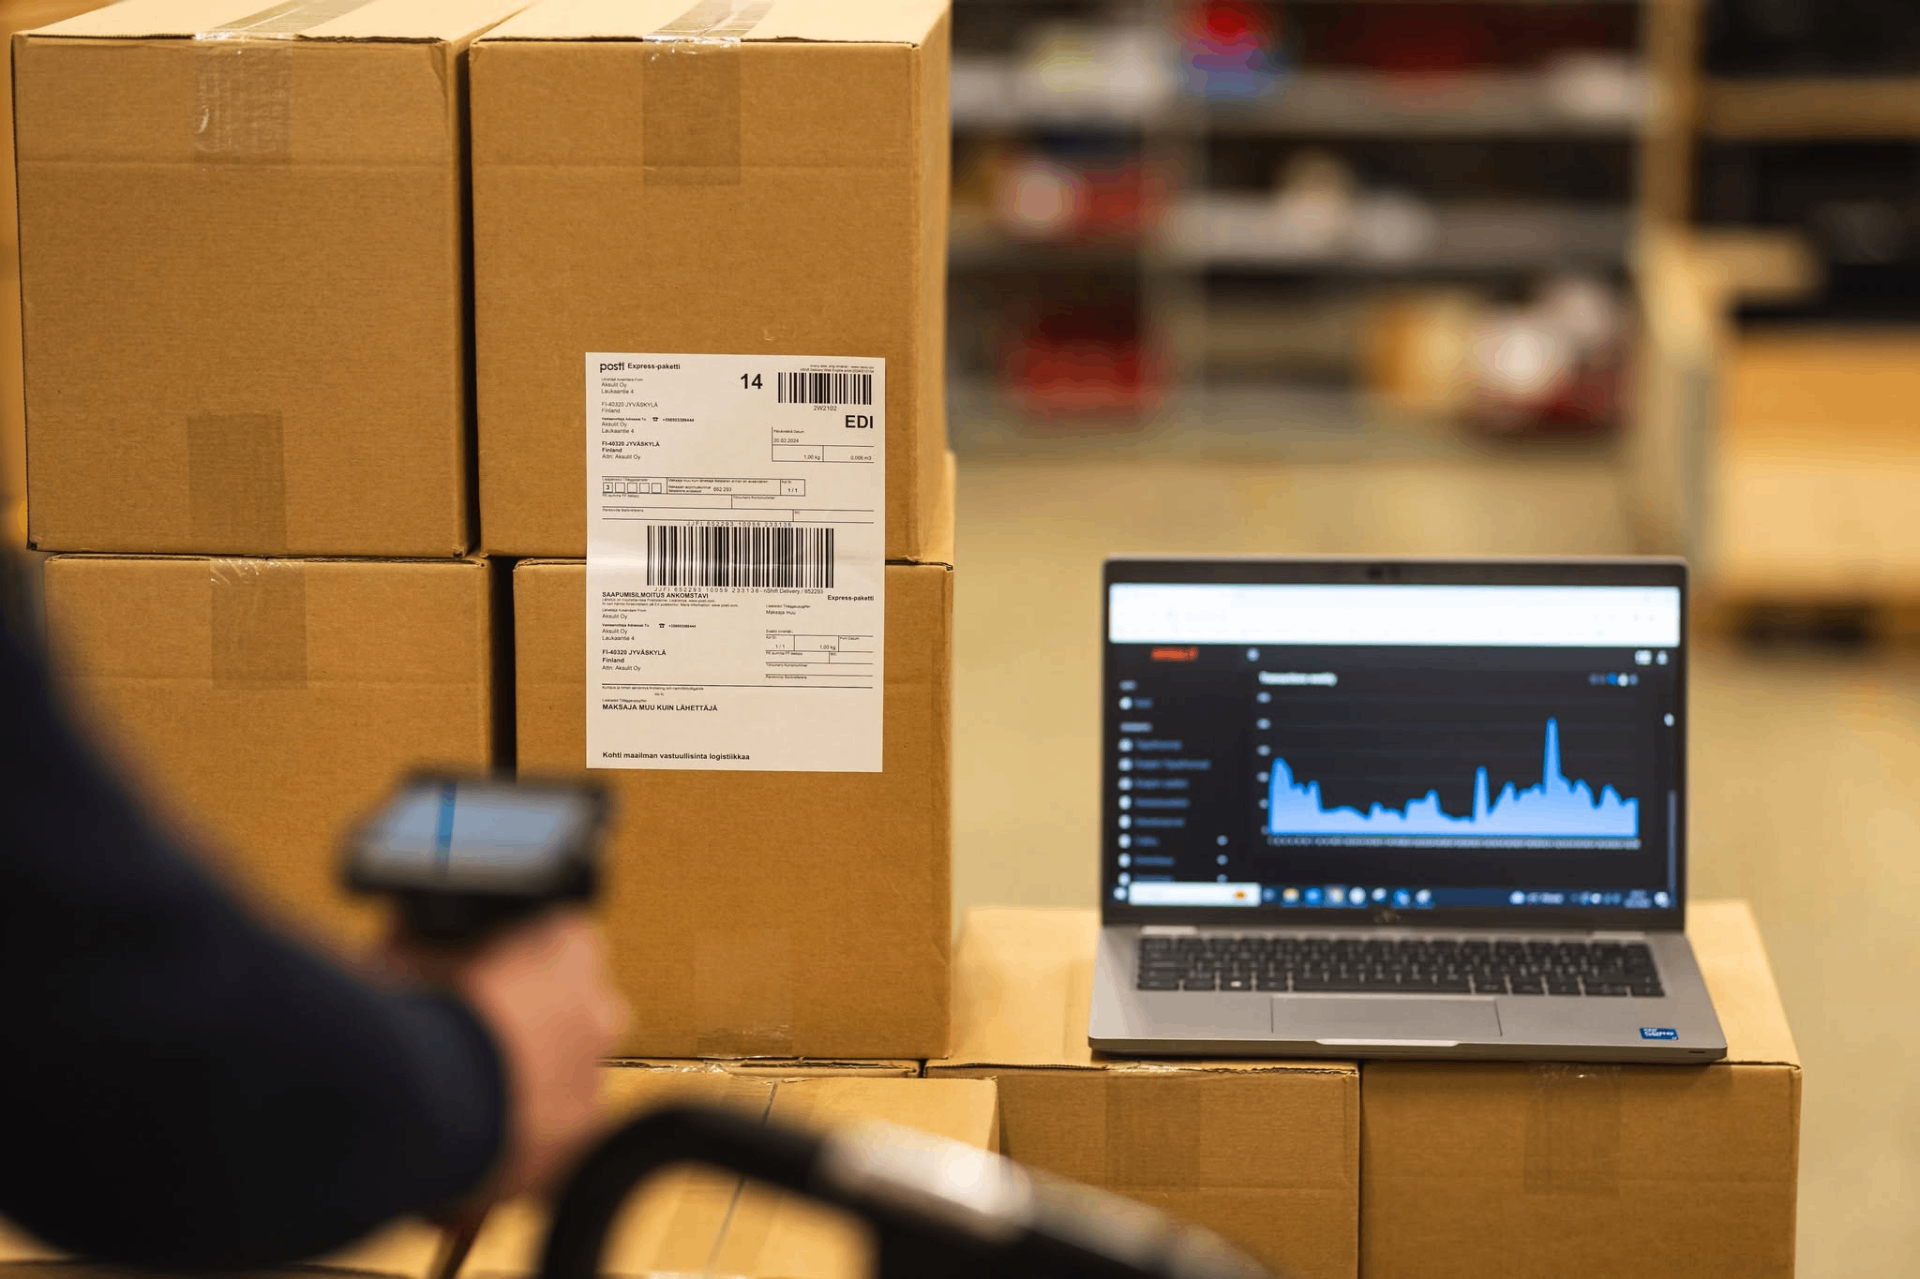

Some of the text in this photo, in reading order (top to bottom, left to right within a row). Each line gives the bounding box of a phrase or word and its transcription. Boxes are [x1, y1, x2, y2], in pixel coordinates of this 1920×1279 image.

[600, 362, 624, 373] posti
[740, 373, 763, 390] 14
[845, 415, 874, 429] EDI
[676, 704, 718, 712] LÄHETTÄJÄ
[710, 753, 750, 762] logistiikkaa
